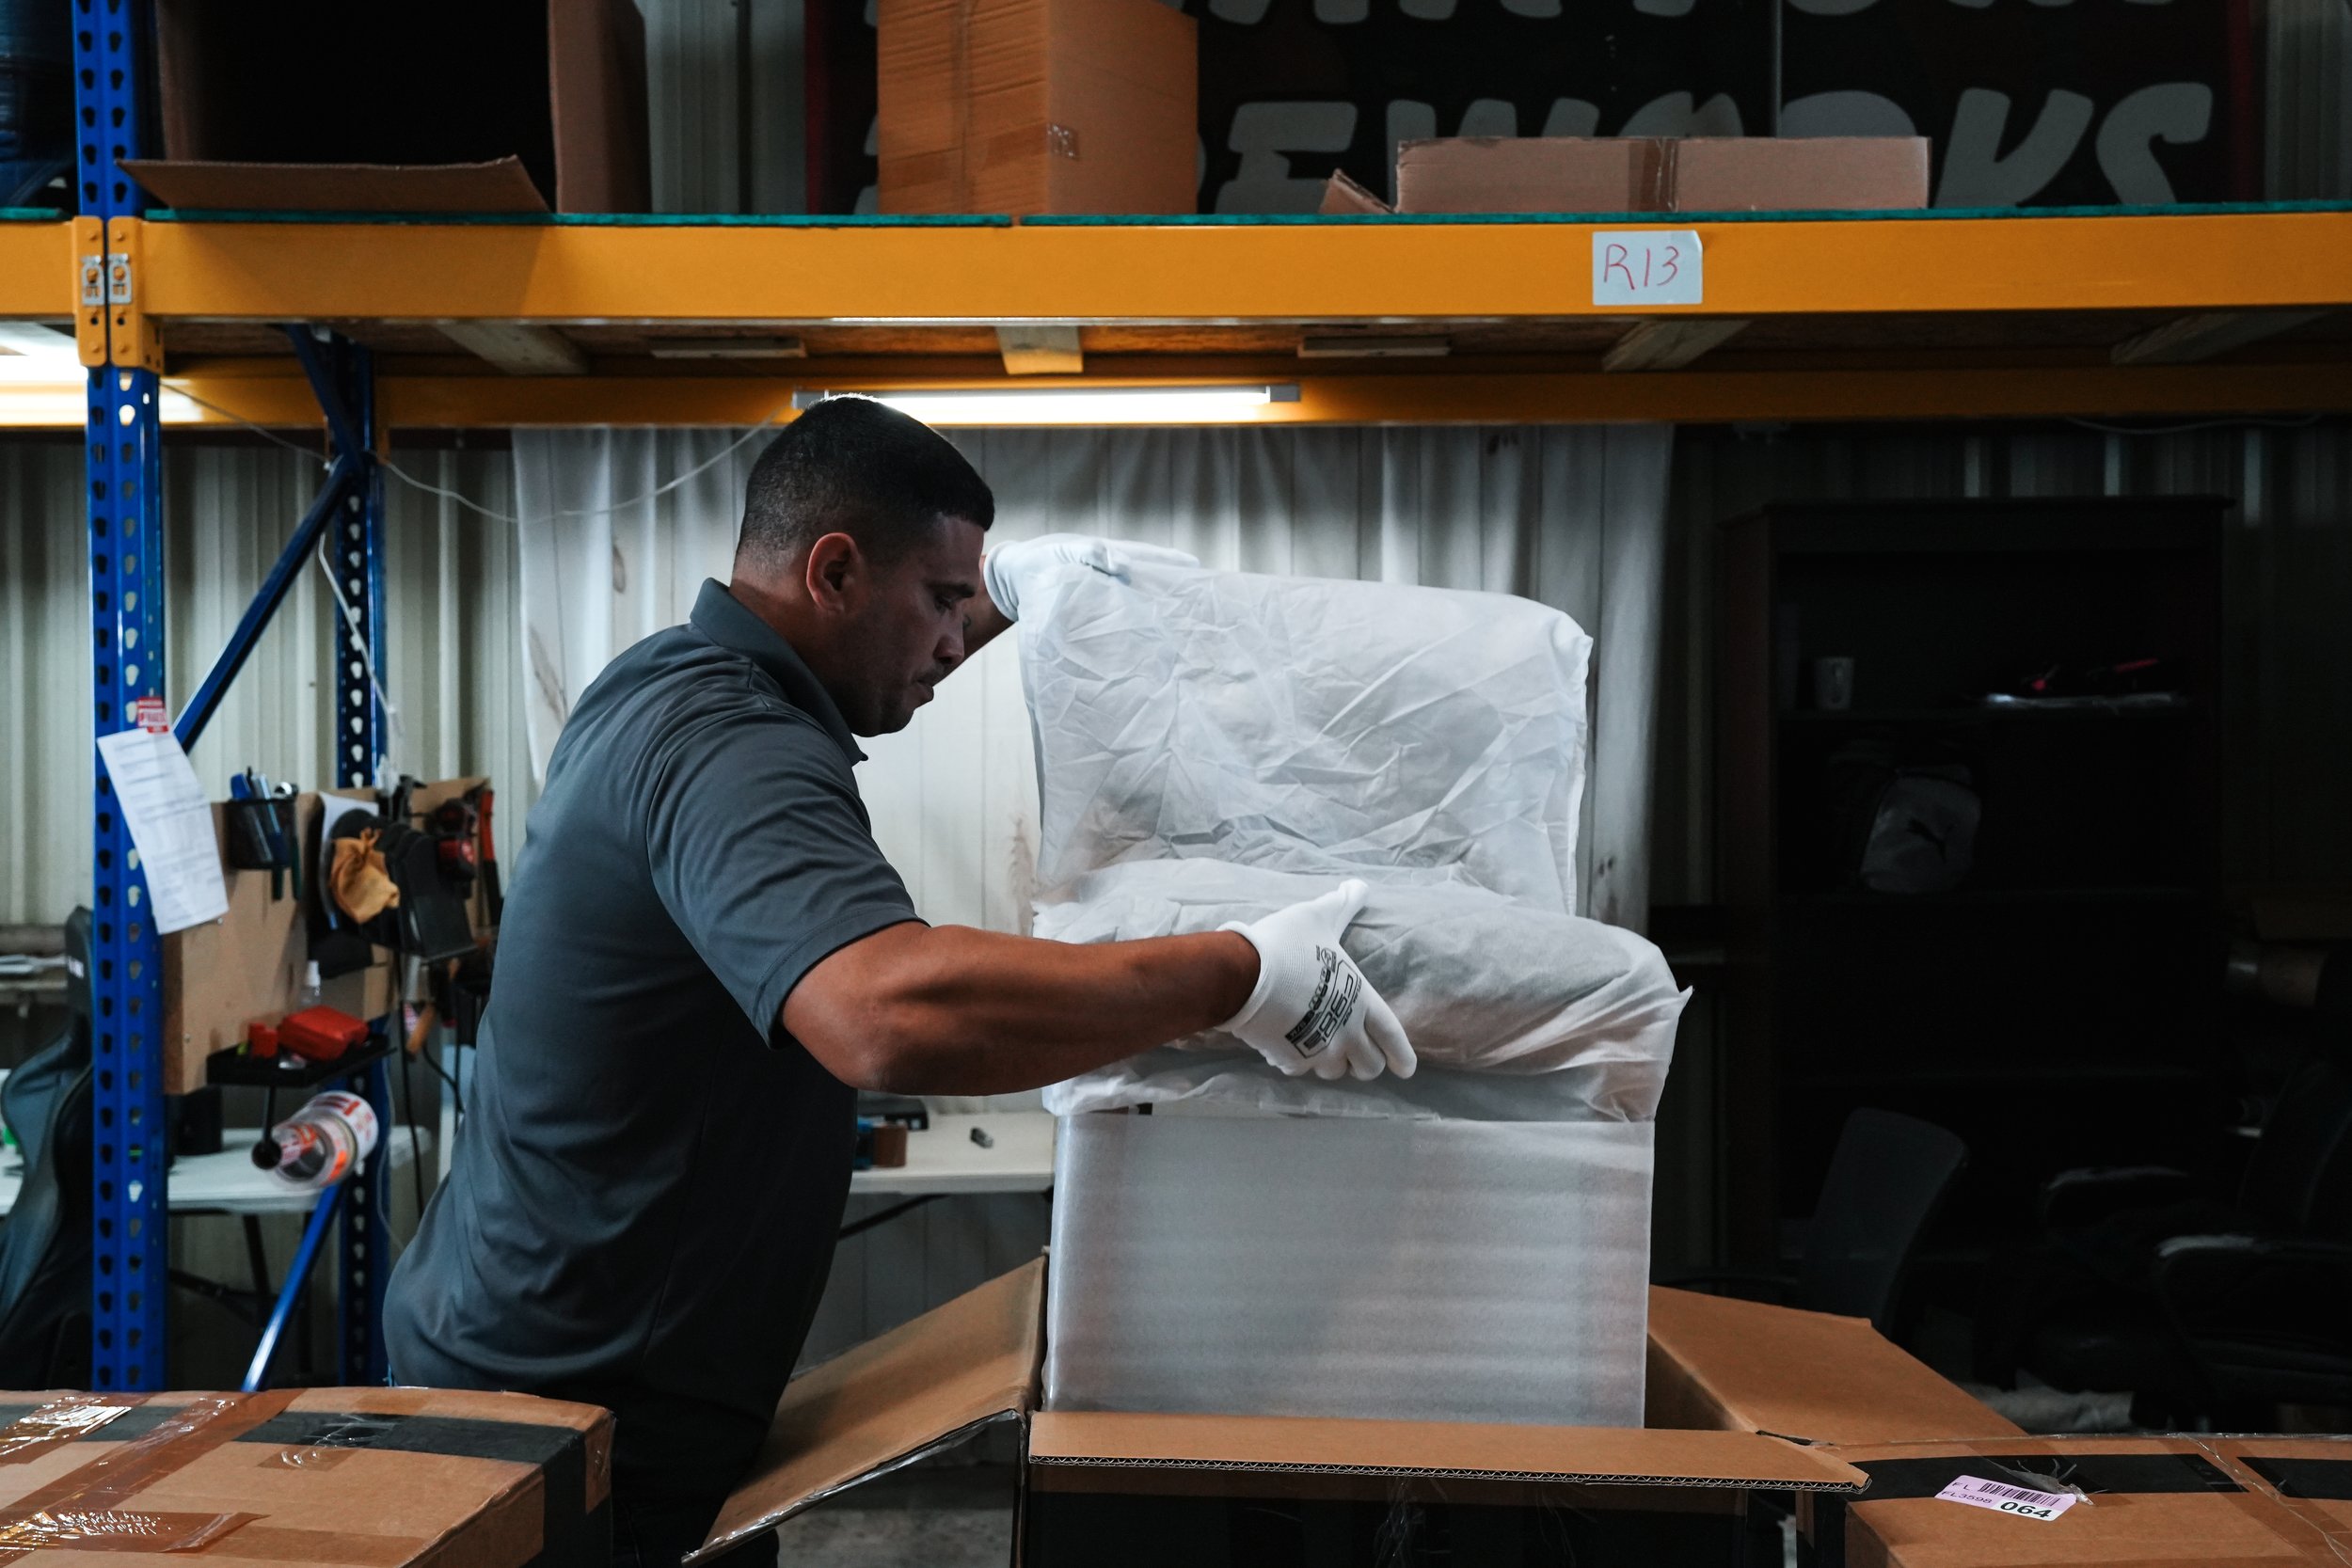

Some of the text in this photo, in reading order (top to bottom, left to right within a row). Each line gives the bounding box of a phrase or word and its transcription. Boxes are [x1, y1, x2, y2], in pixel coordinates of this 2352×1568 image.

[1603, 244, 1679, 291] R13
[1941, 1491, 1993, 1504] FL3598
[2000, 1502, 2053, 1518] 064
